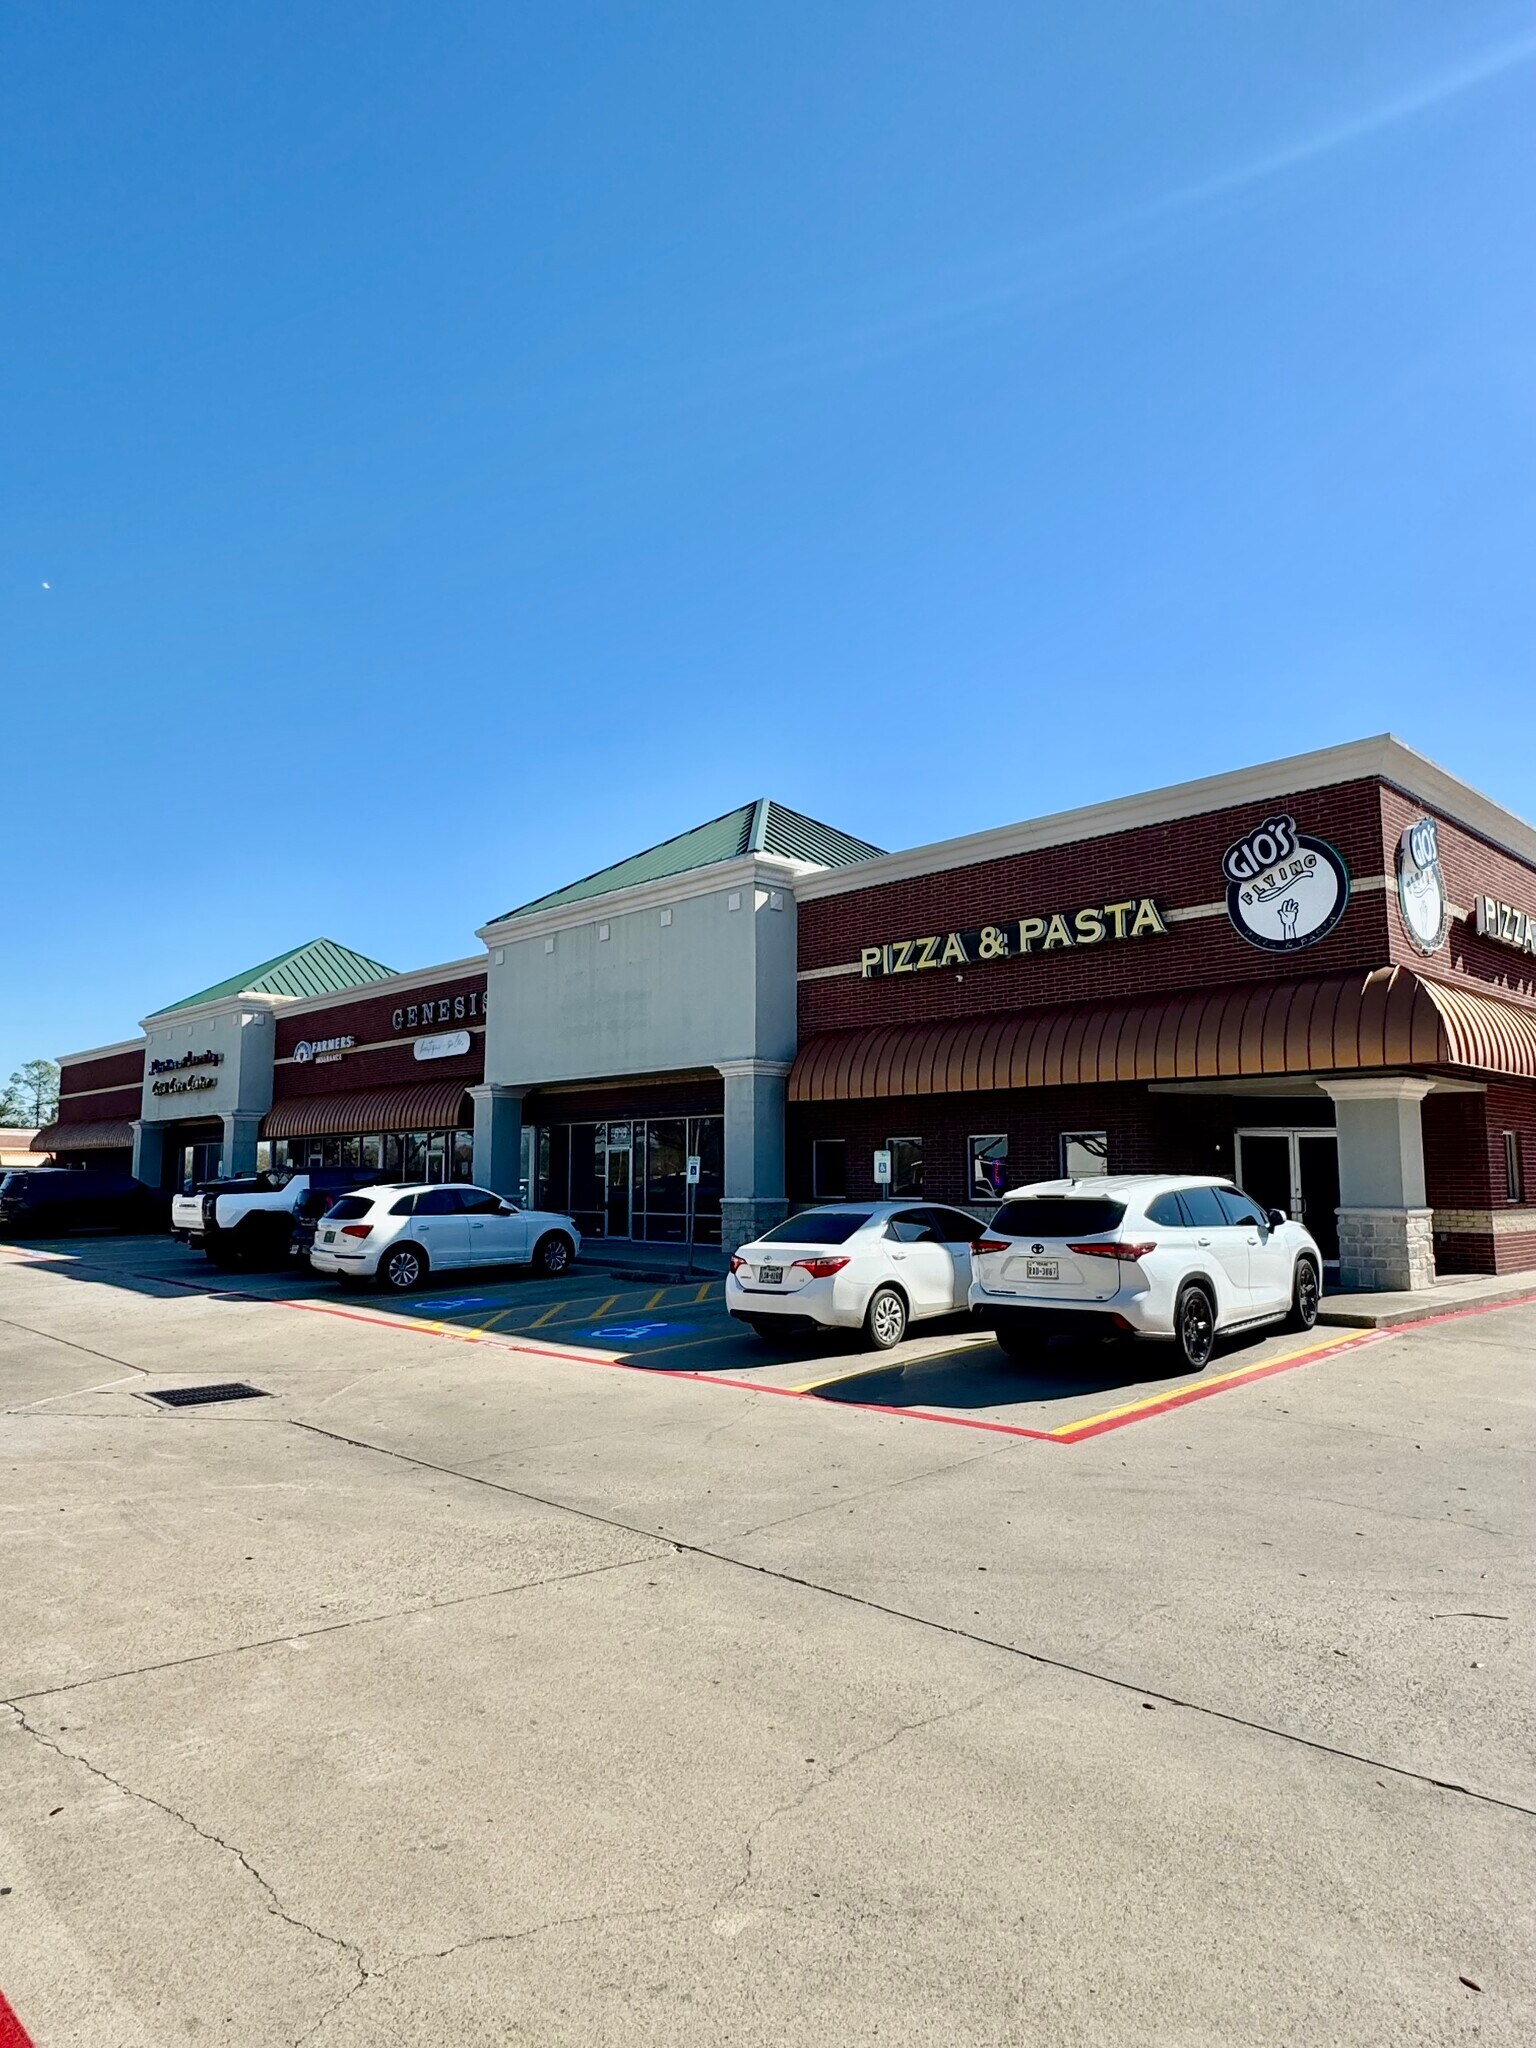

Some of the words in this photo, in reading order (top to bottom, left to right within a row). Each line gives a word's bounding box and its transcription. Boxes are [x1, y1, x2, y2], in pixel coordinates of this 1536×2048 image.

[1228, 822, 1290, 878] GIO'S
[1241, 854, 1317, 906] FLYING
[861, 932, 970, 978] PIZZA
[978, 926, 1006, 959] &
[1018, 899, 1167, 953] PASTA
[1483, 896, 1535, 951] PIZZA
[312, 1036, 352, 1053] FARMERS
